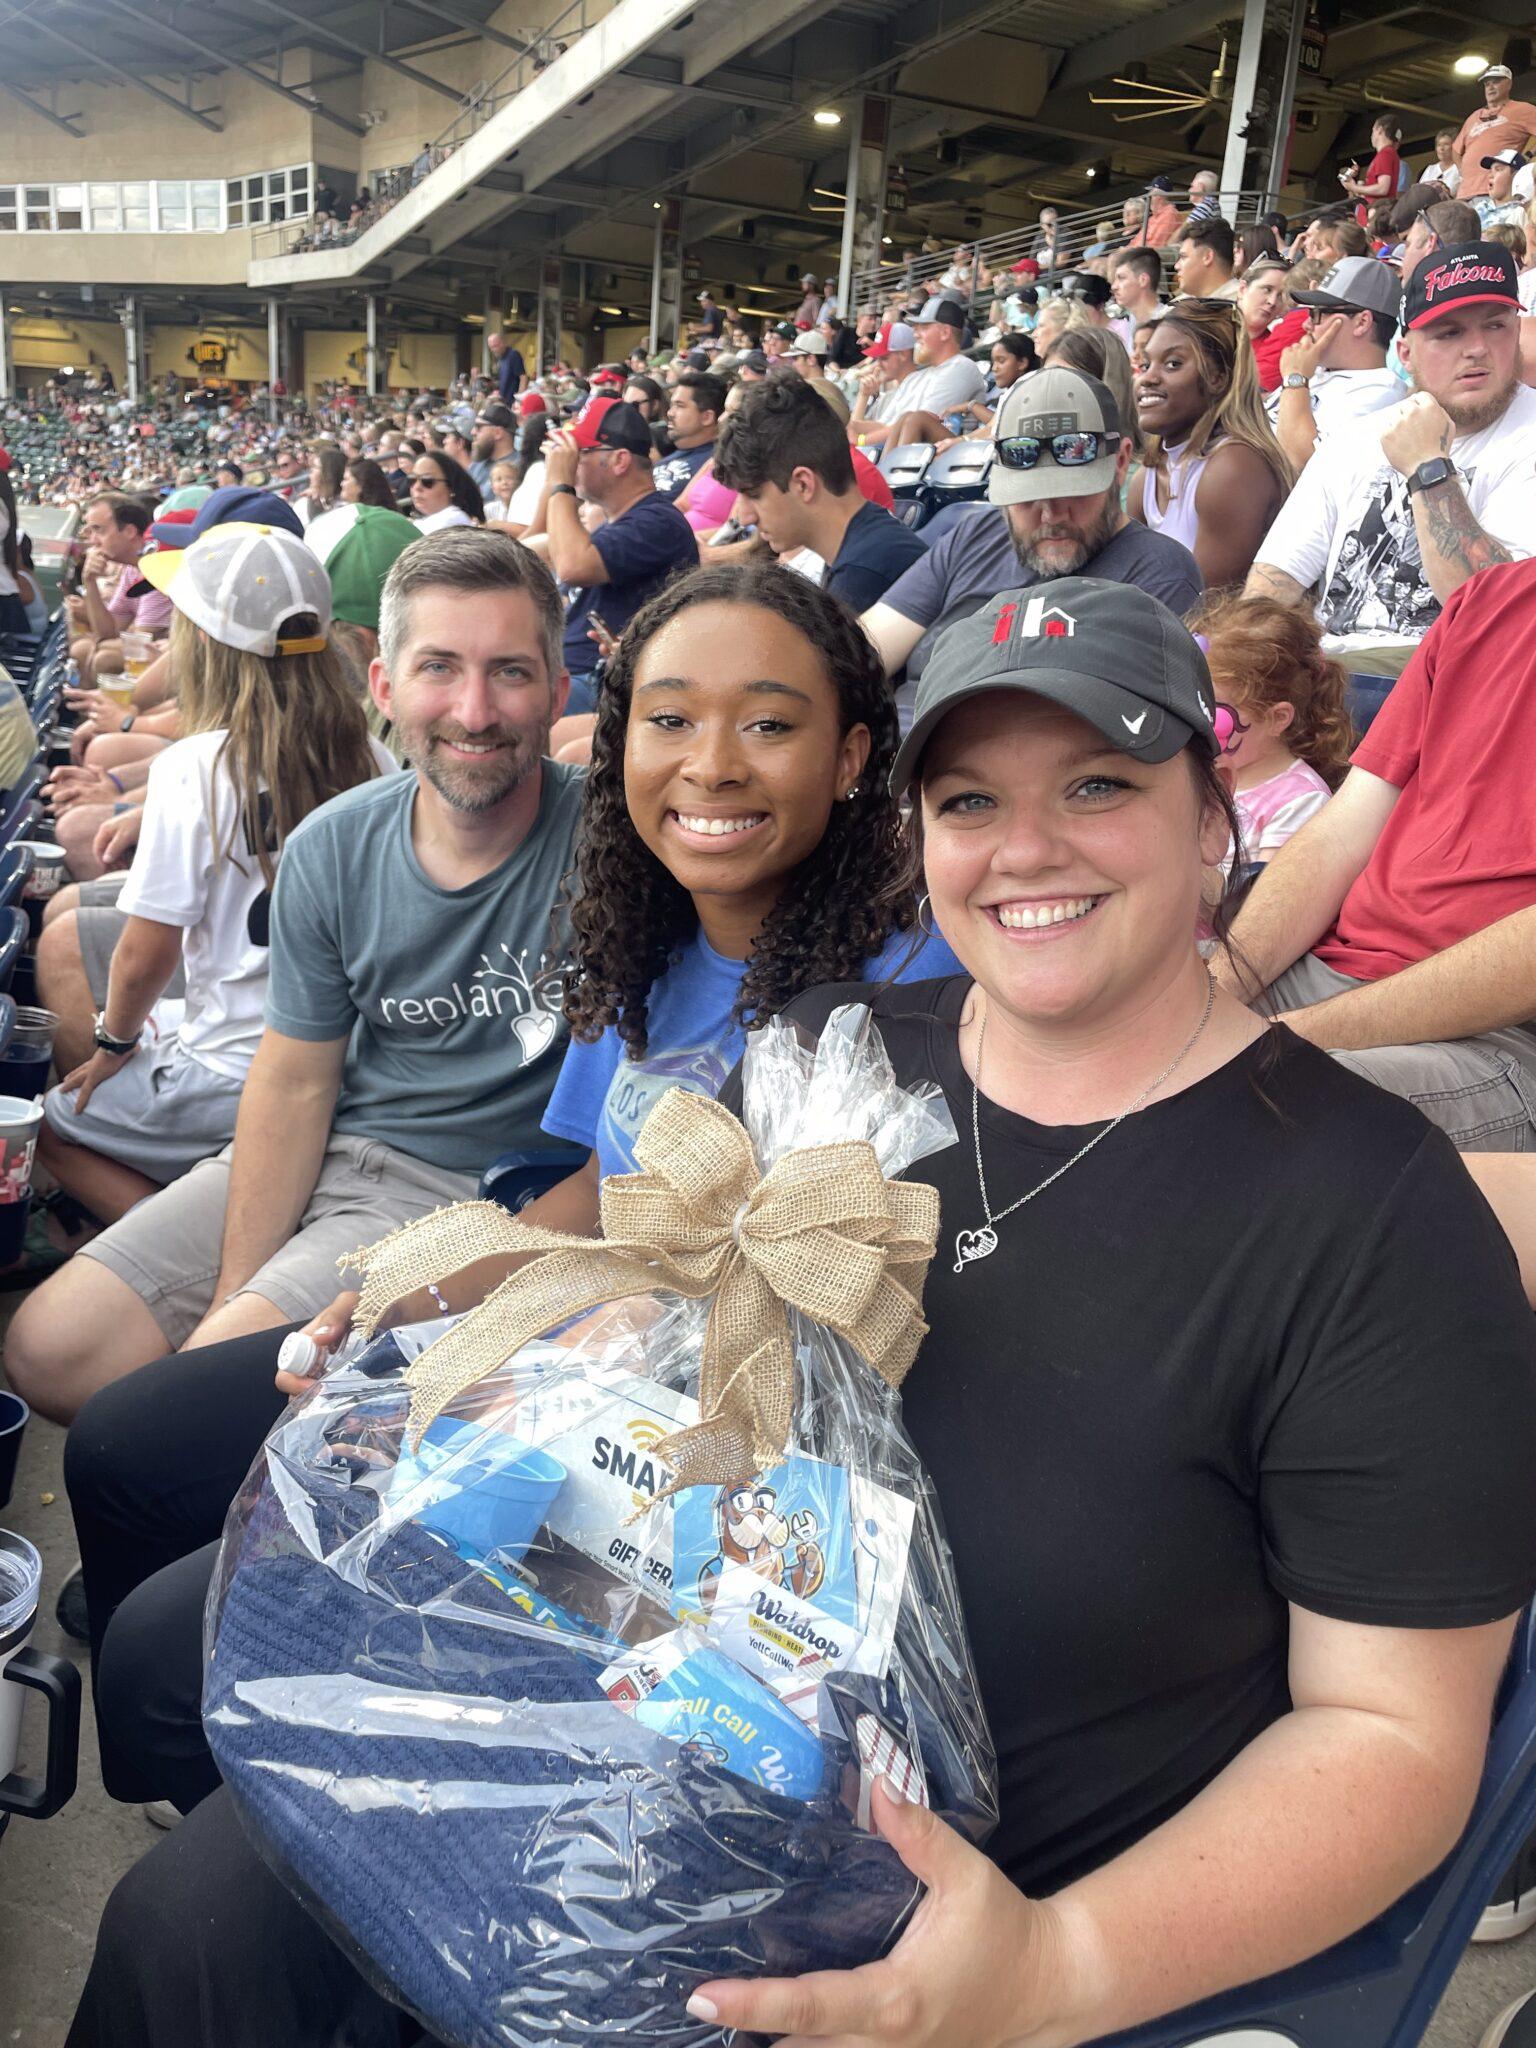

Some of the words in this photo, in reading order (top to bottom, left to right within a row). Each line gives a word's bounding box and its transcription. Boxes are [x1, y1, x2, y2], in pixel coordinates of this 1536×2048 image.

[1450, 254, 1479, 265] ATLANTA
[1424, 263, 1506, 301] Falcons
[750, 1588, 843, 1661] Waldrop
[712, 1703, 758, 1745] Call
